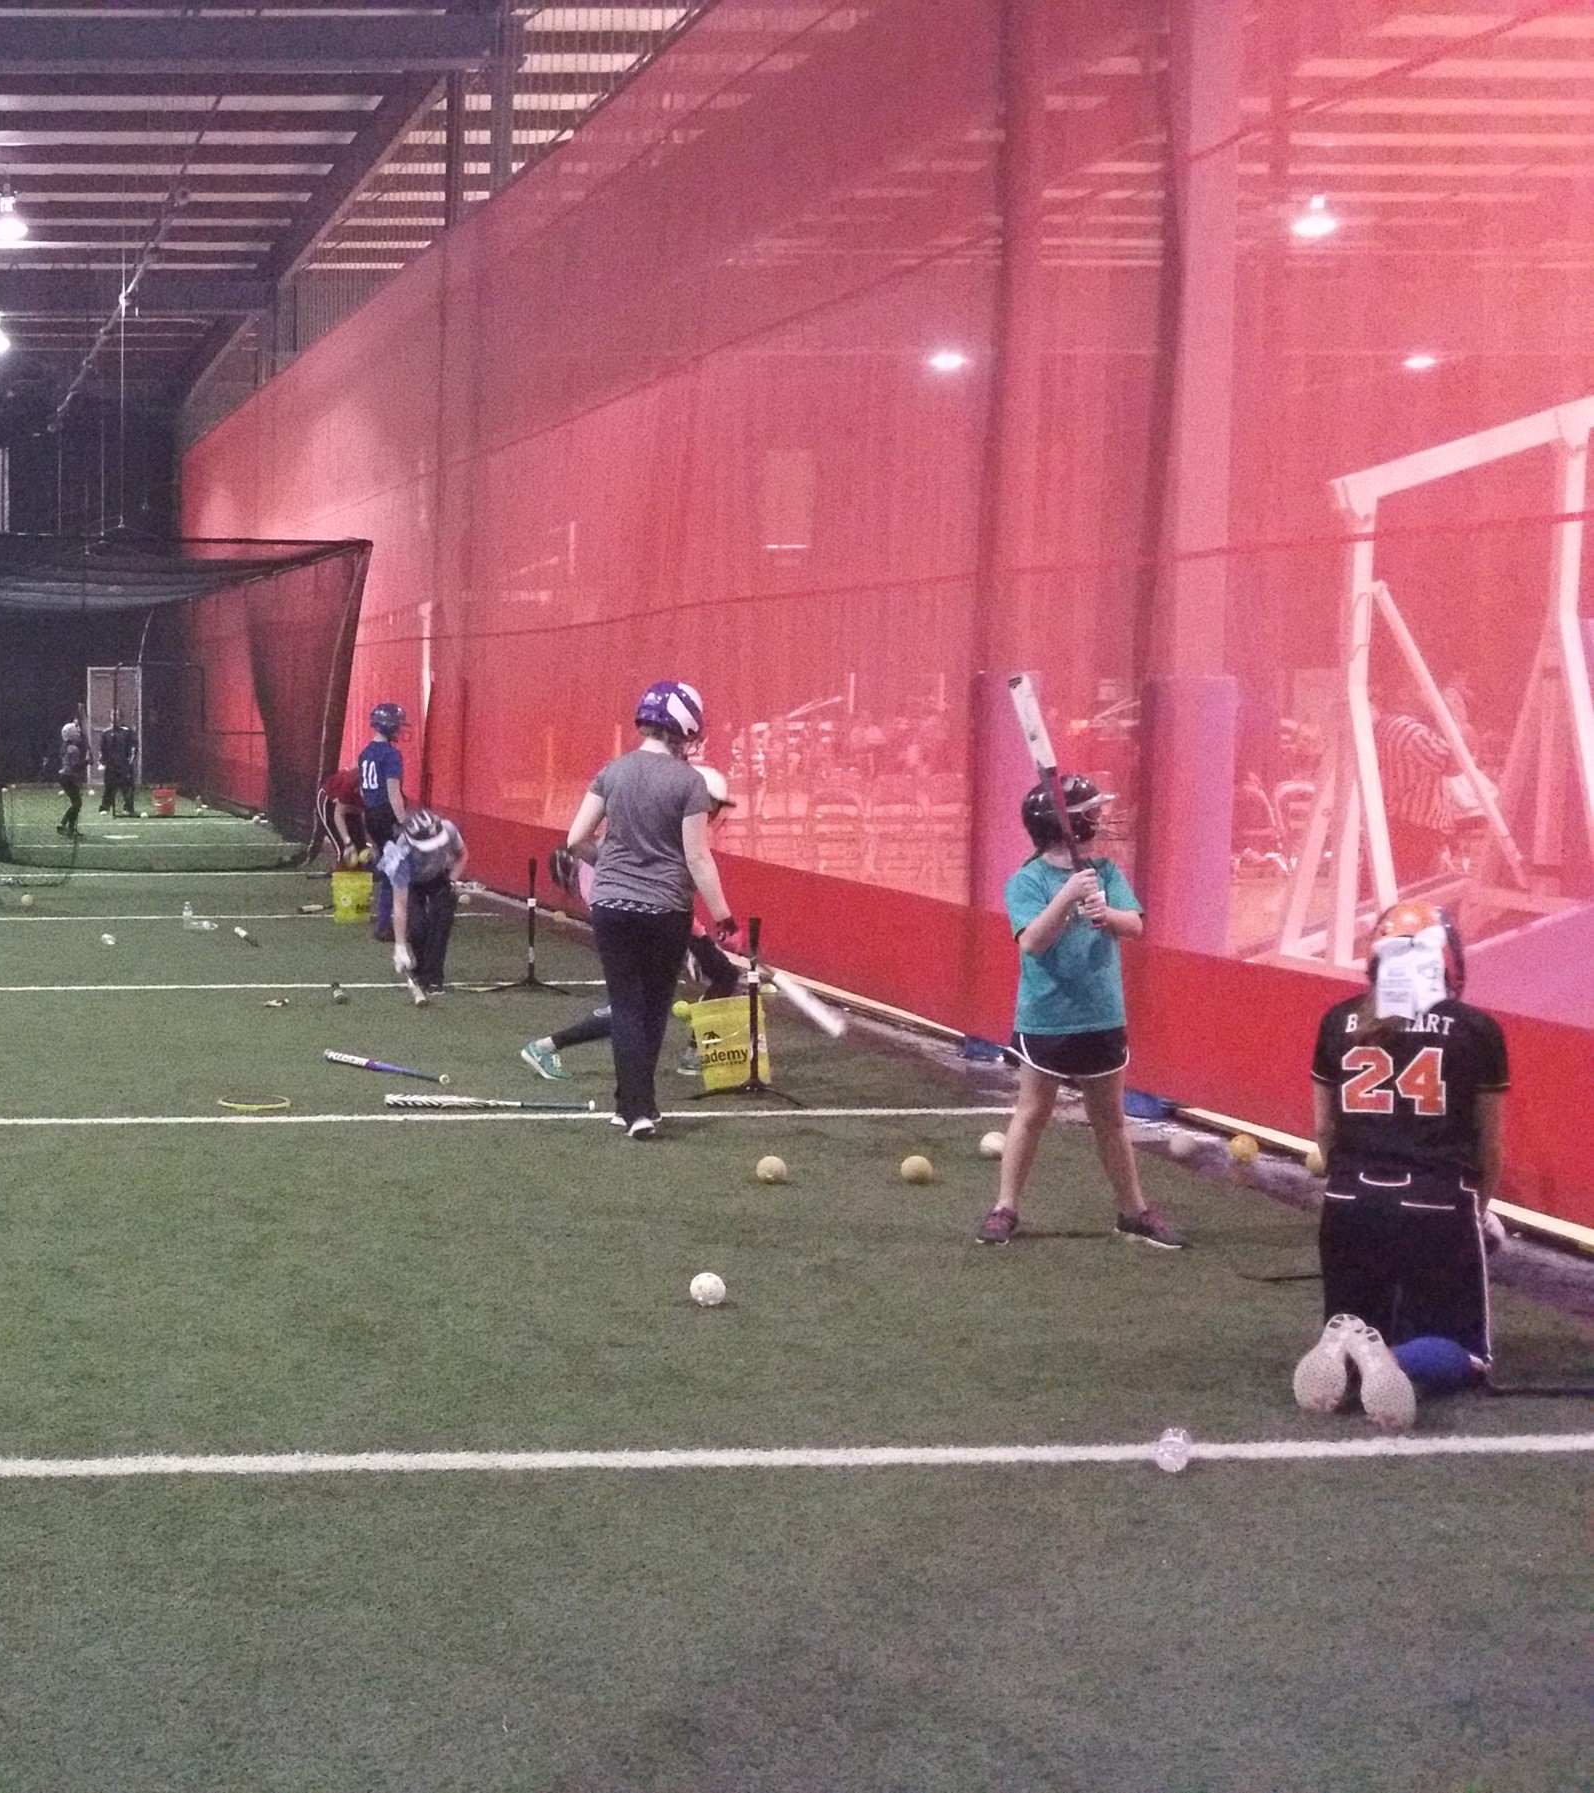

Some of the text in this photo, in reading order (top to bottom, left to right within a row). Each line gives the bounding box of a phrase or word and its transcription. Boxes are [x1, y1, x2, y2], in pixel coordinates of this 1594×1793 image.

[362, 760, 378, 789] 10
[1345, 1013, 1454, 1035] BART
[702, 1049, 748, 1064] ademy
[1342, 1046, 1446, 1116] 24
